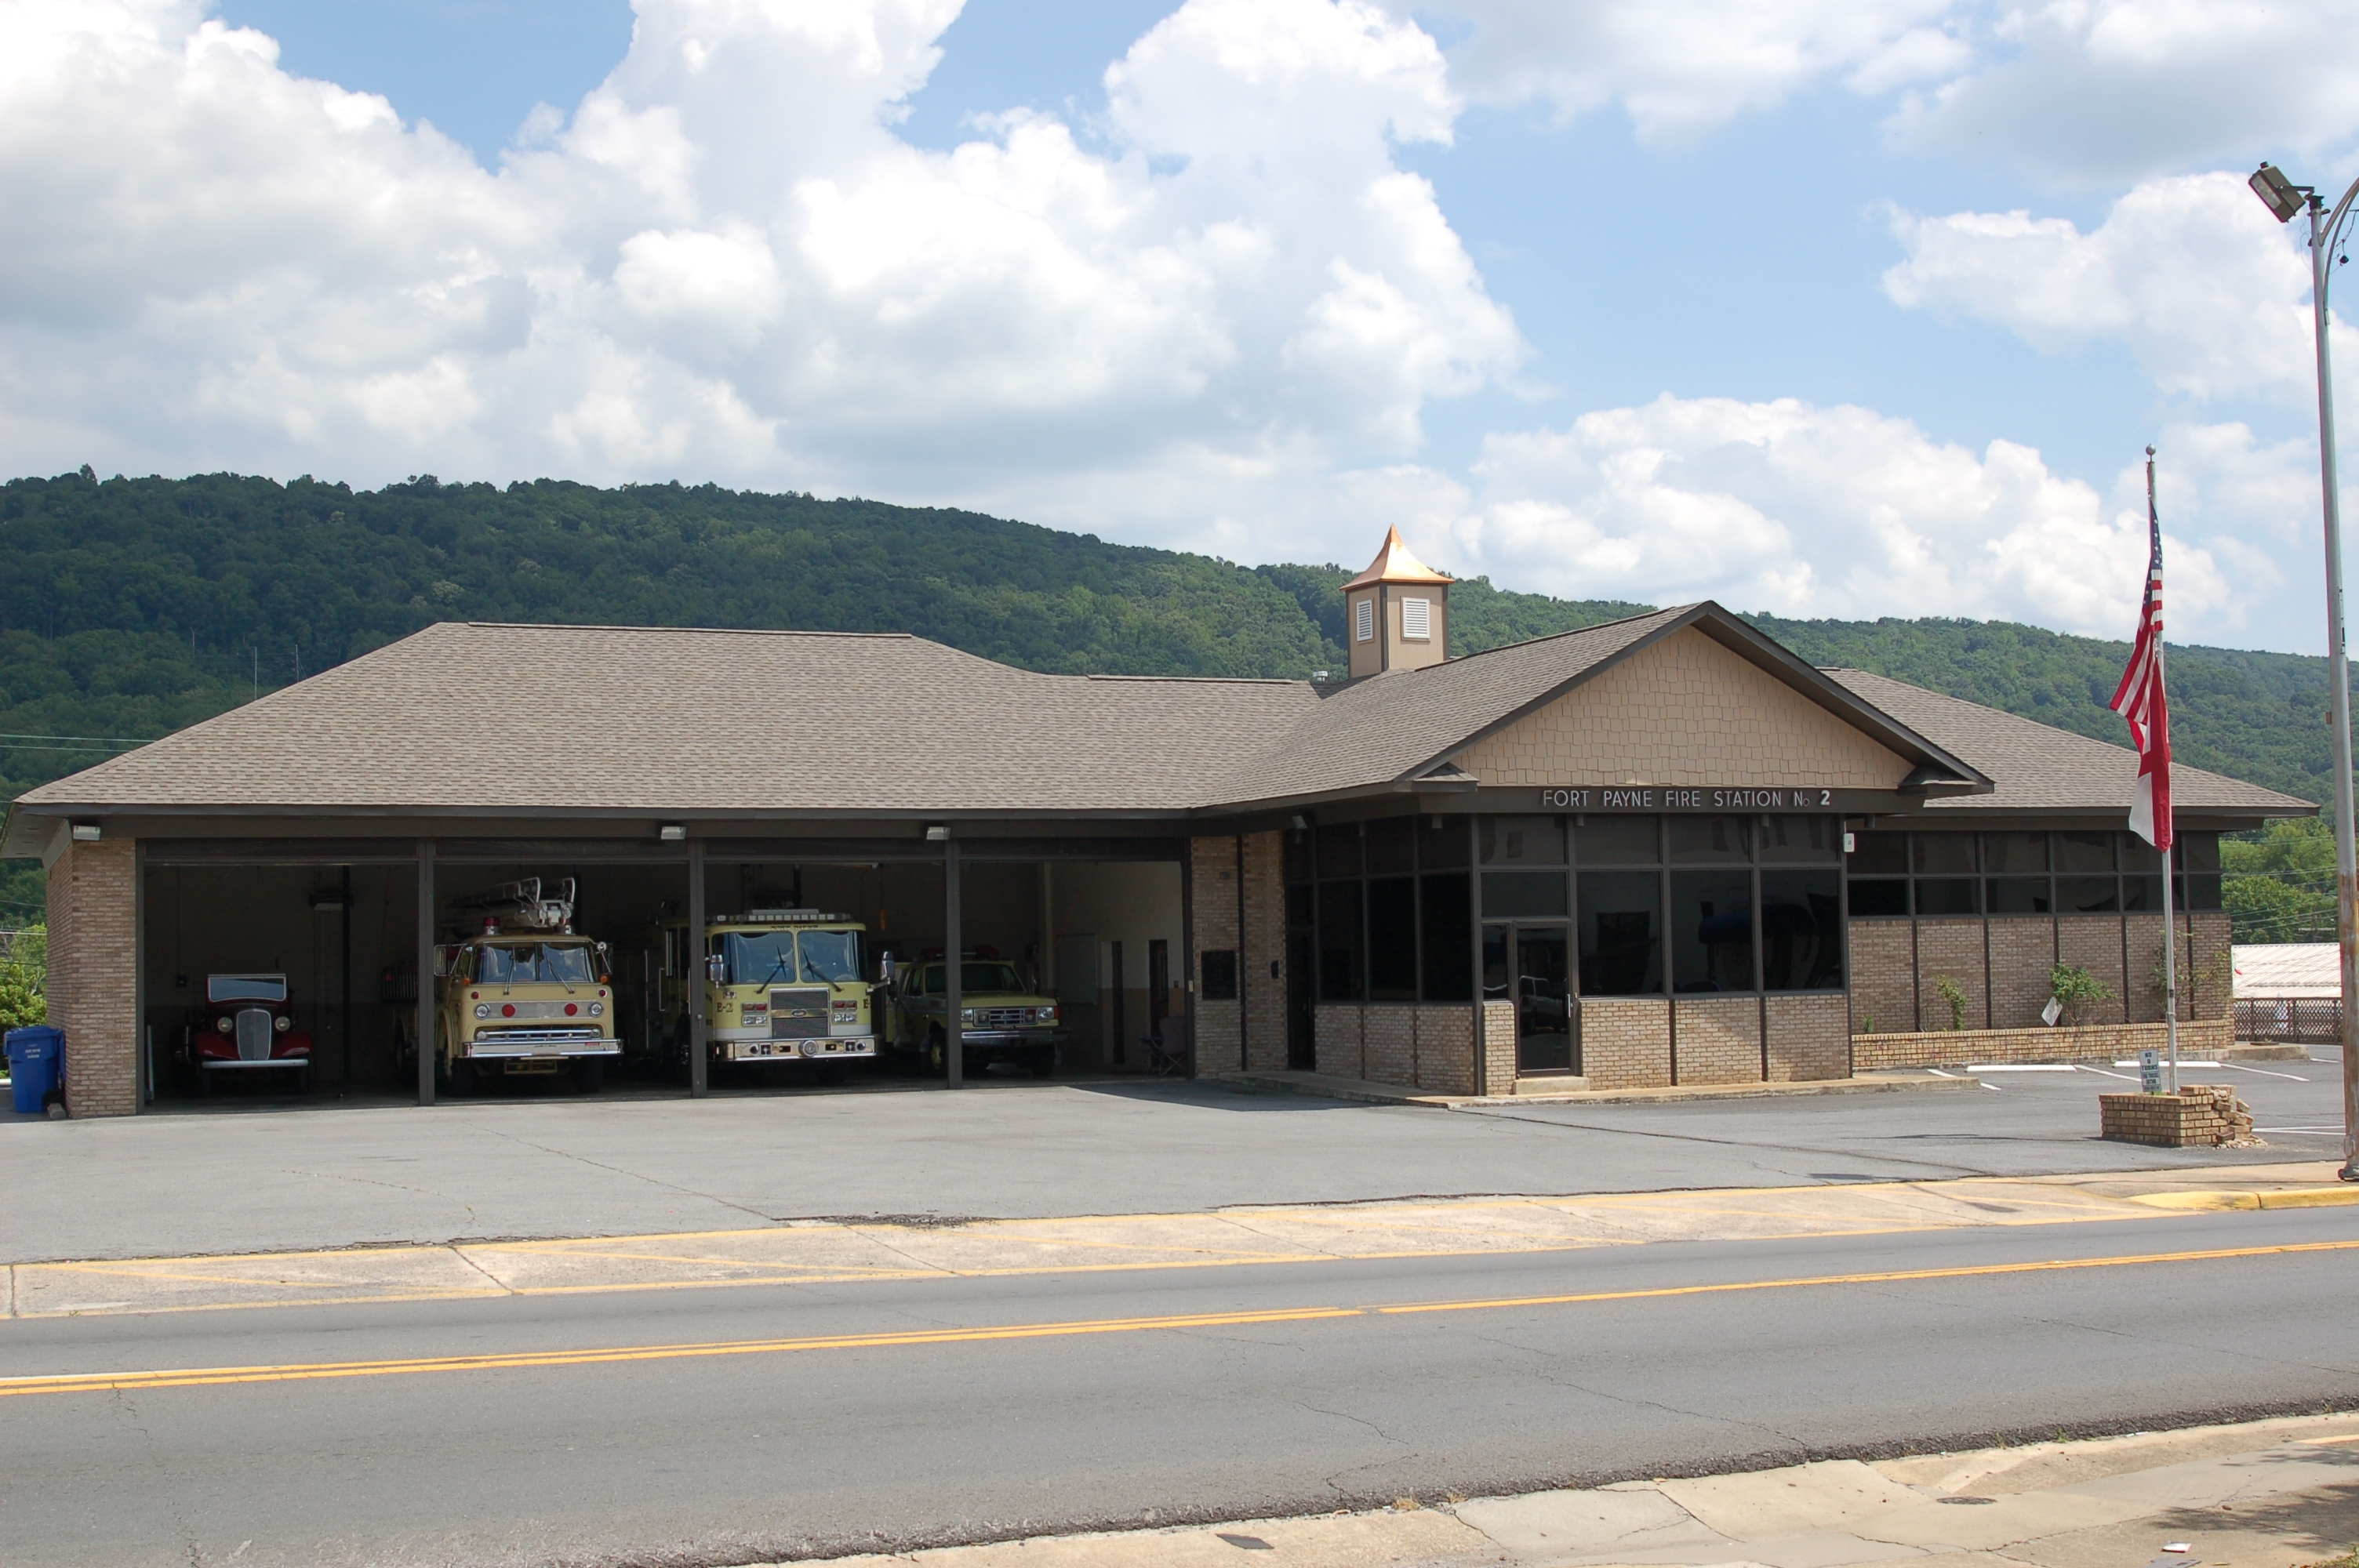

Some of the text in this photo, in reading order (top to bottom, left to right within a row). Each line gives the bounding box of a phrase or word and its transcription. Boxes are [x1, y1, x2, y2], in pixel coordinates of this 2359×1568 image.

[1543, 789, 1589, 807] FORT
[1603, 790, 1652, 807] PAYNE
[1665, 790, 1700, 807] FIRE
[1714, 790, 1782, 807] STATION
[1820, 789, 1830, 805] 2
[717, 1002, 733, 1012] E-2
